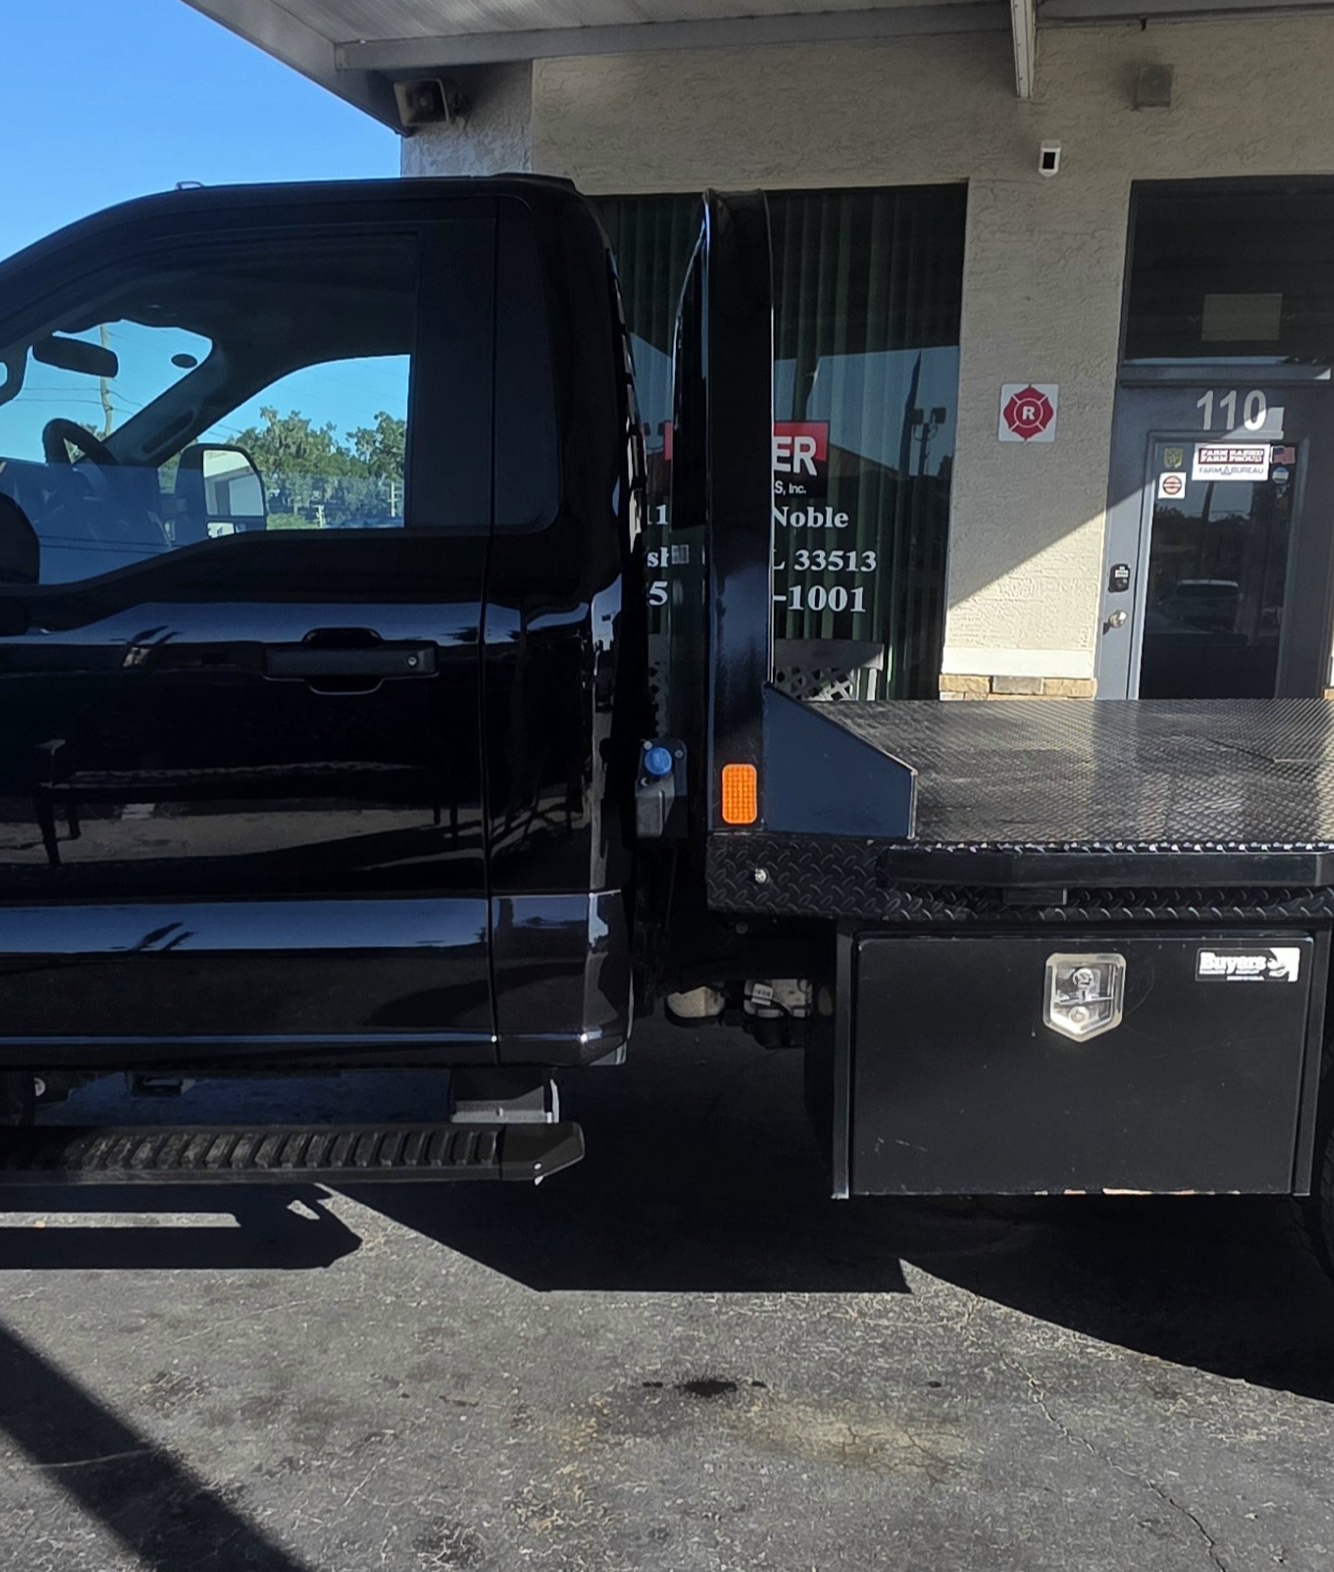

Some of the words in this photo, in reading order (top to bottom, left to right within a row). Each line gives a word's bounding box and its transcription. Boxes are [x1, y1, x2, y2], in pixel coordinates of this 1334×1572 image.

[1022, 406, 1035, 420] R
[1197, 390, 1267, 431] 110
[773, 435, 818, 476] ER
[1199, 466, 1222, 474] FARM
[789, 483, 807, 495] Inc.
[772, 506, 849, 528] Noble
[794, 549, 877, 572] 33513
[773, 585, 866, 613] -1001
